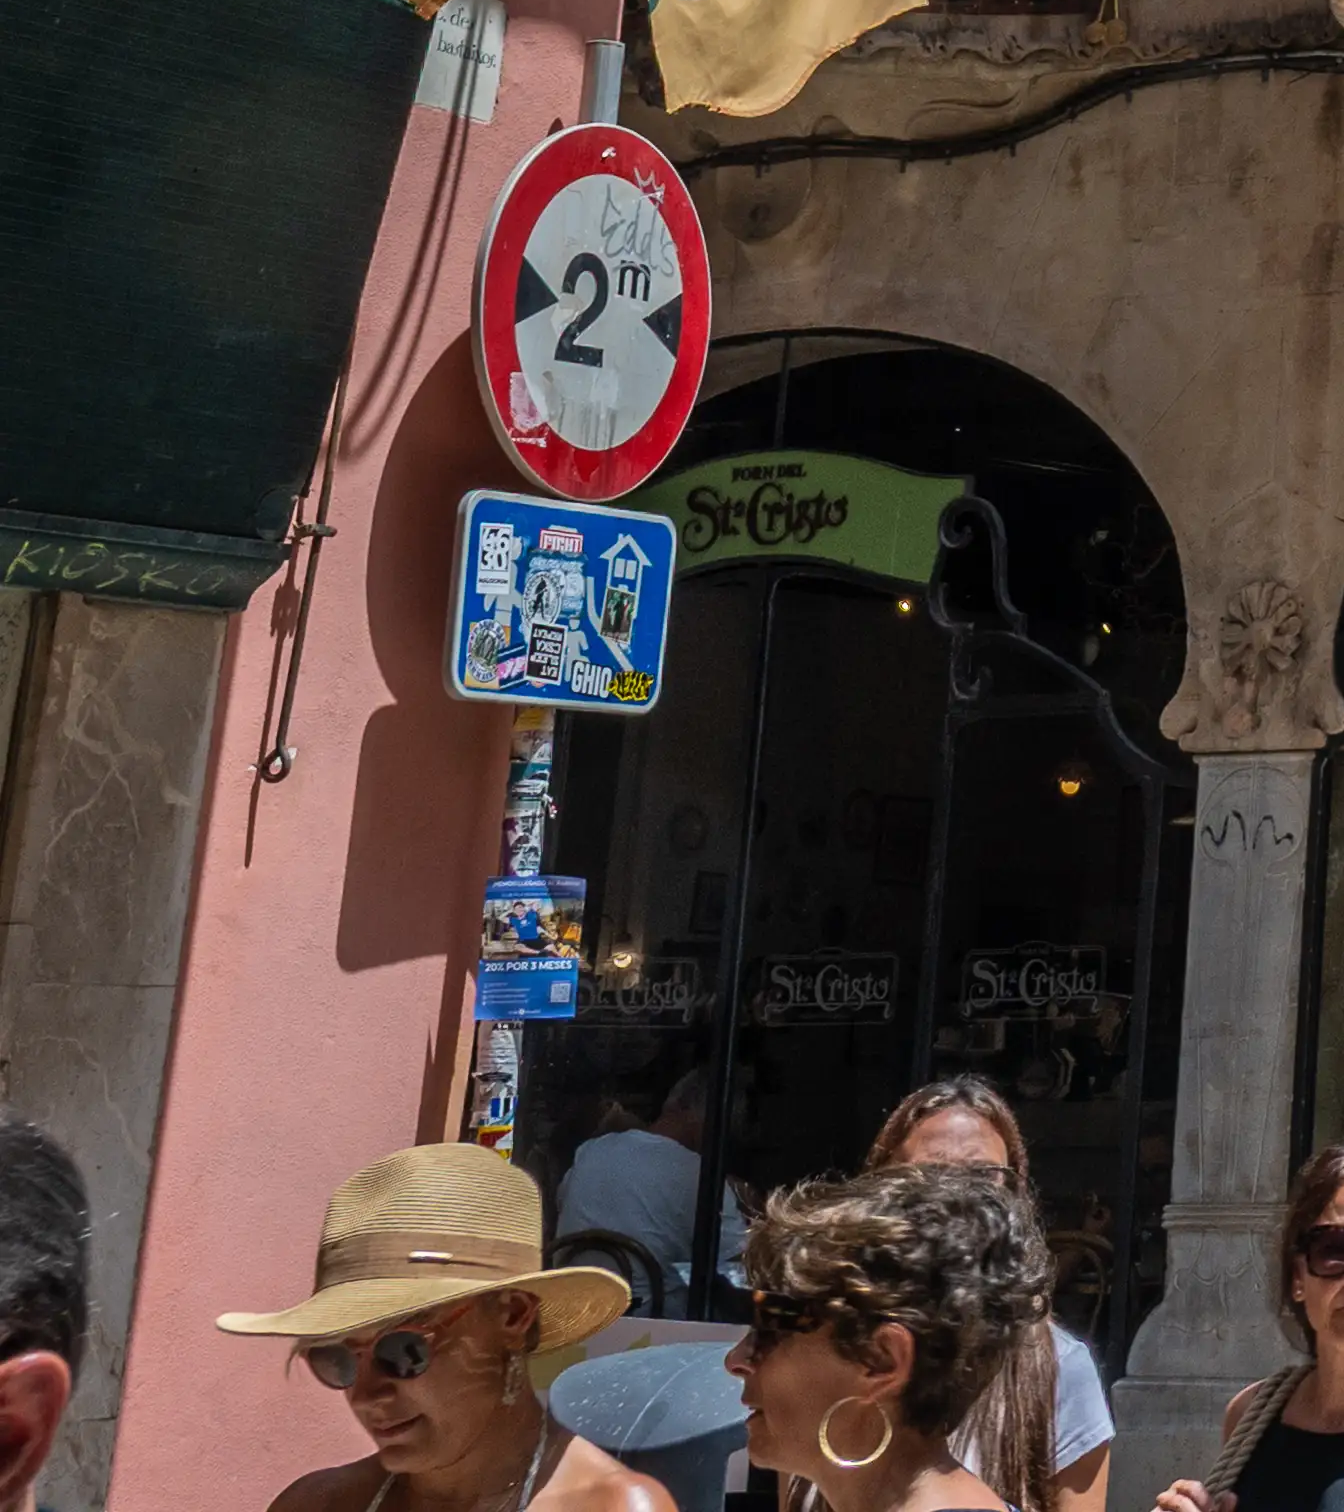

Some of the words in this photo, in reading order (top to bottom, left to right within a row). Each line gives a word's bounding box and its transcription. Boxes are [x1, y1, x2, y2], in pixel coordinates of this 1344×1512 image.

[746, 482, 849, 546] Cristo
[506, 962, 529, 972] POR
[530, 961, 537, 971] 3
[538, 960, 572, 971] MESES
[814, 965, 890, 1011] Cristo
[1018, 958, 1097, 1006] Cristo
